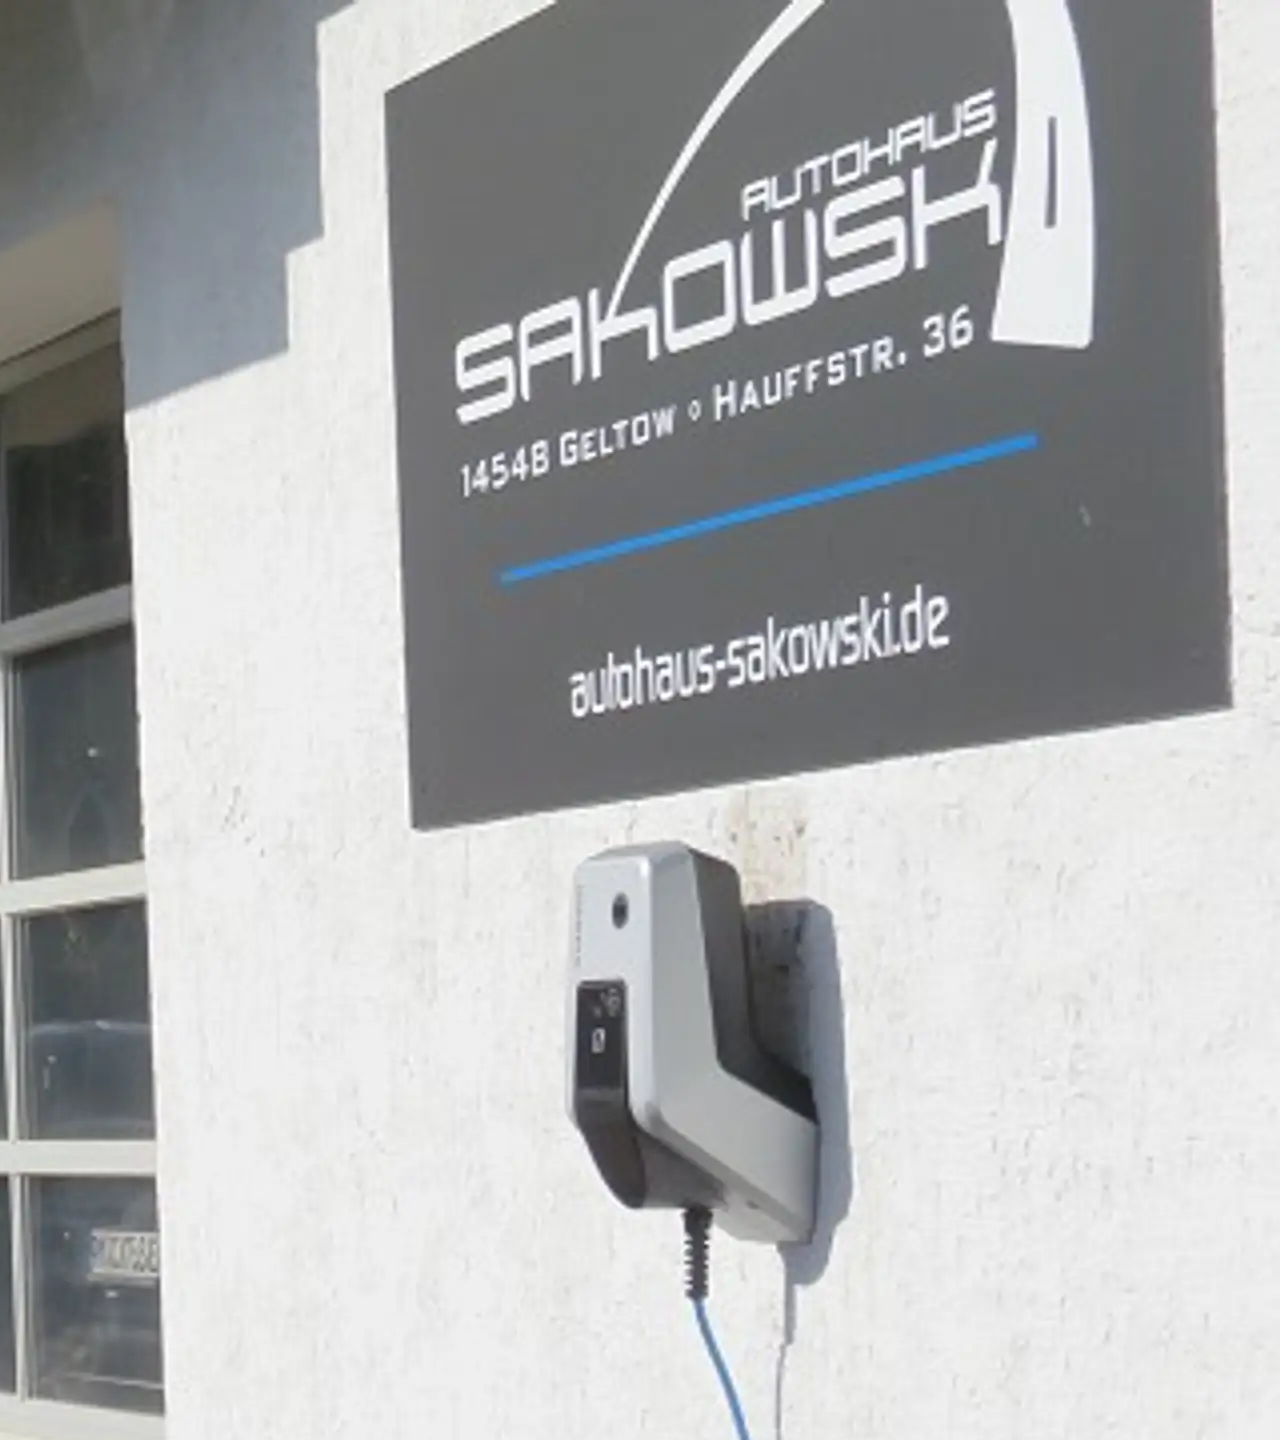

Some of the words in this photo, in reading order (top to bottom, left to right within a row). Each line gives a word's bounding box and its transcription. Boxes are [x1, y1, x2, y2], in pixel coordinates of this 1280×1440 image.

[741, 88, 997, 221] AUTOHAUS
[558, 406, 678, 468] GELTOW
[713, 335, 908, 421] HAUFFSTR.
[922, 304, 975, 358] 36
[568, 583, 951, 718] autohaus-sakowski.de
